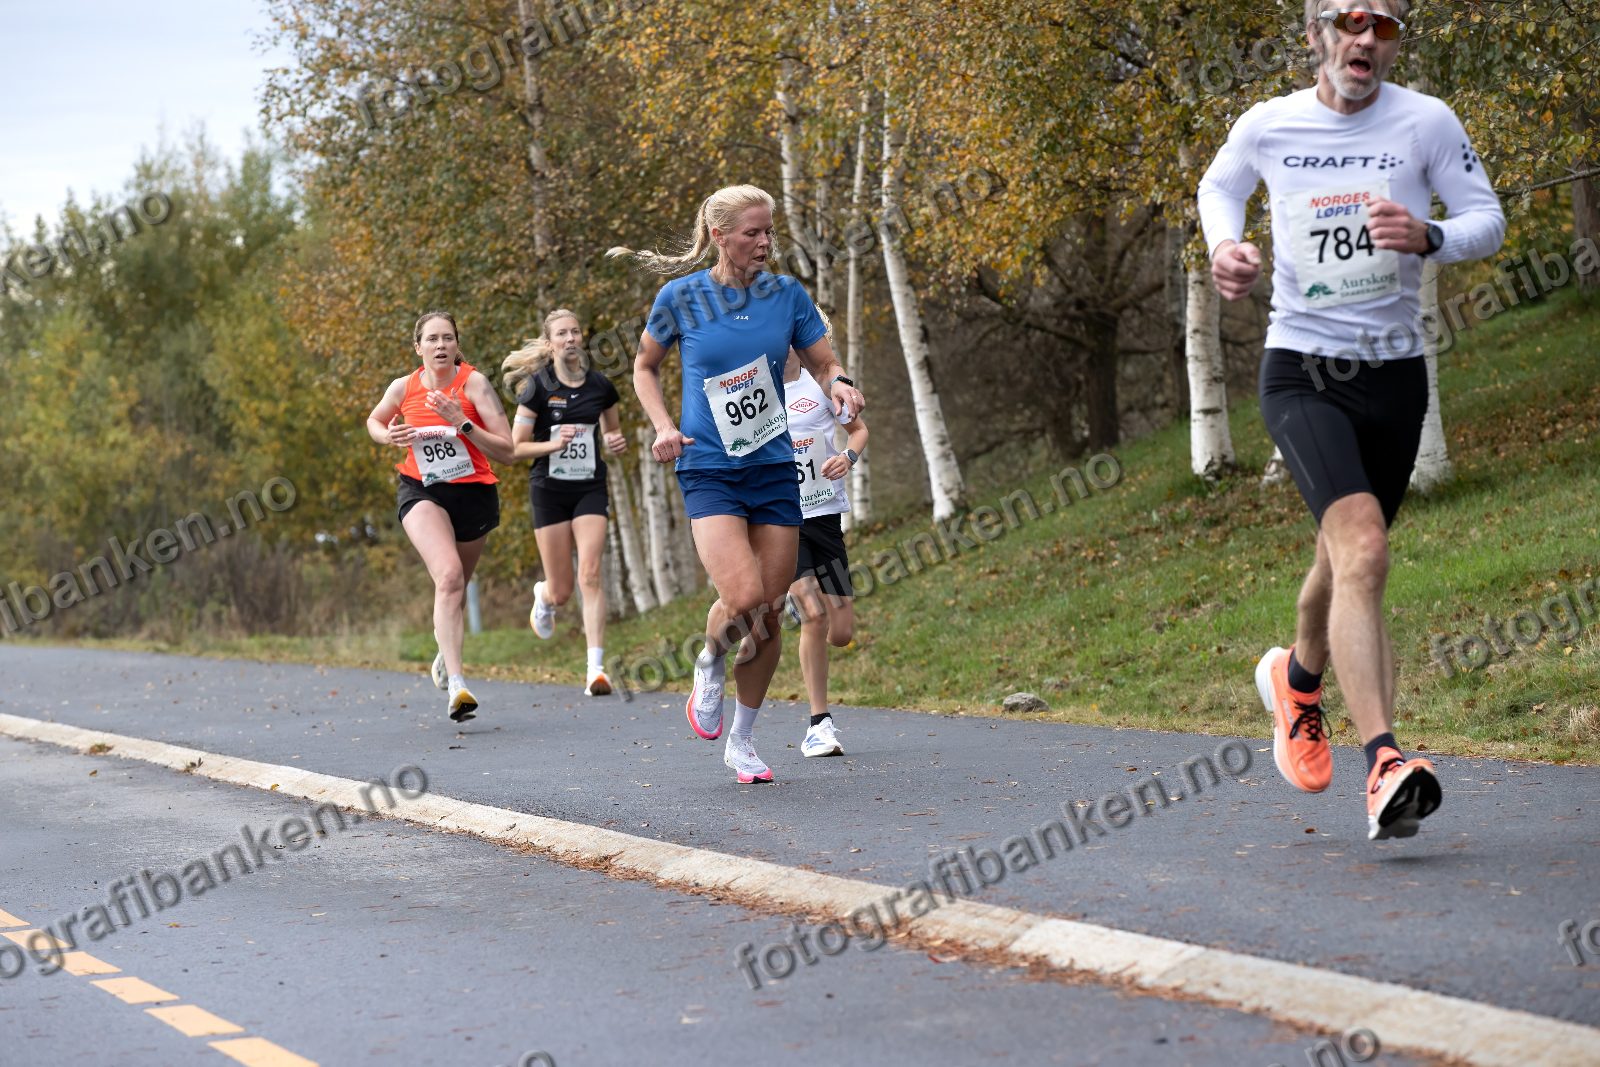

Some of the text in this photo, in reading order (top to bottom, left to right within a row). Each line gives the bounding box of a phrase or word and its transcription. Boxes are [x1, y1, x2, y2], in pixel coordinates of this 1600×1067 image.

[1283, 156, 1375, 168] CRAFT
[1311, 192, 1370, 208] NORGES
[1315, 204, 1361, 219] LØPET
[1310, 224, 1374, 264] 784
[1339, 271, 1397, 291] Aurskog
[719, 367, 759, 389] NORGES
[725, 377, 755, 395] LØPET
[725, 388, 769, 427] 962
[752, 412, 786, 439] Aurskog
[423, 442, 457, 463] 968
[559, 443, 587, 459] 253
[441, 462, 471, 476] Aurskog
